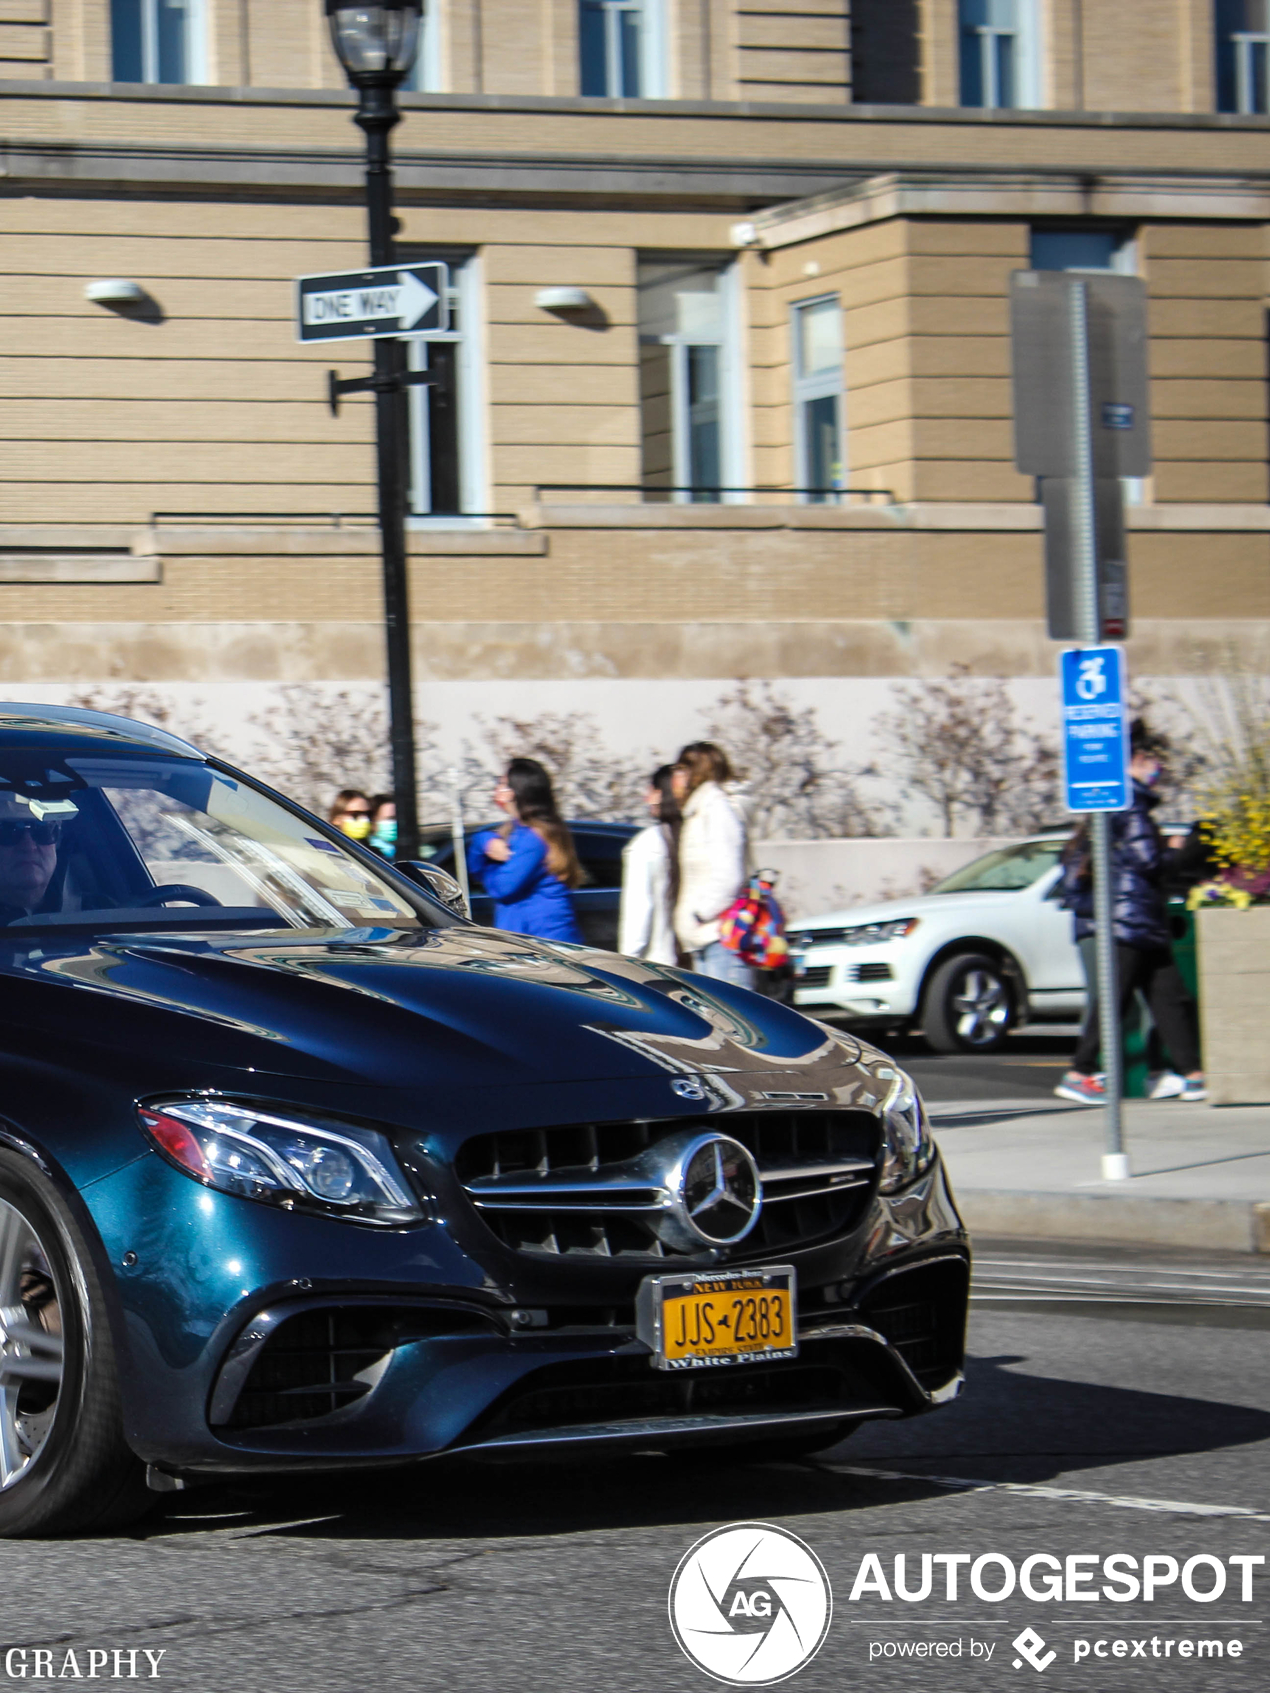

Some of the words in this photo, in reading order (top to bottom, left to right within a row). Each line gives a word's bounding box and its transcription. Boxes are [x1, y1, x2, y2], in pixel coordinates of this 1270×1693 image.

[314, 293, 354, 319] ONE
[359, 289, 401, 315] WAY
[695, 1270, 763, 1281] Mercedes-Benz
[694, 1281, 727, 1294] NEW
[668, 1356, 731, 1369] White
[737, 1350, 793, 1362] Plains
